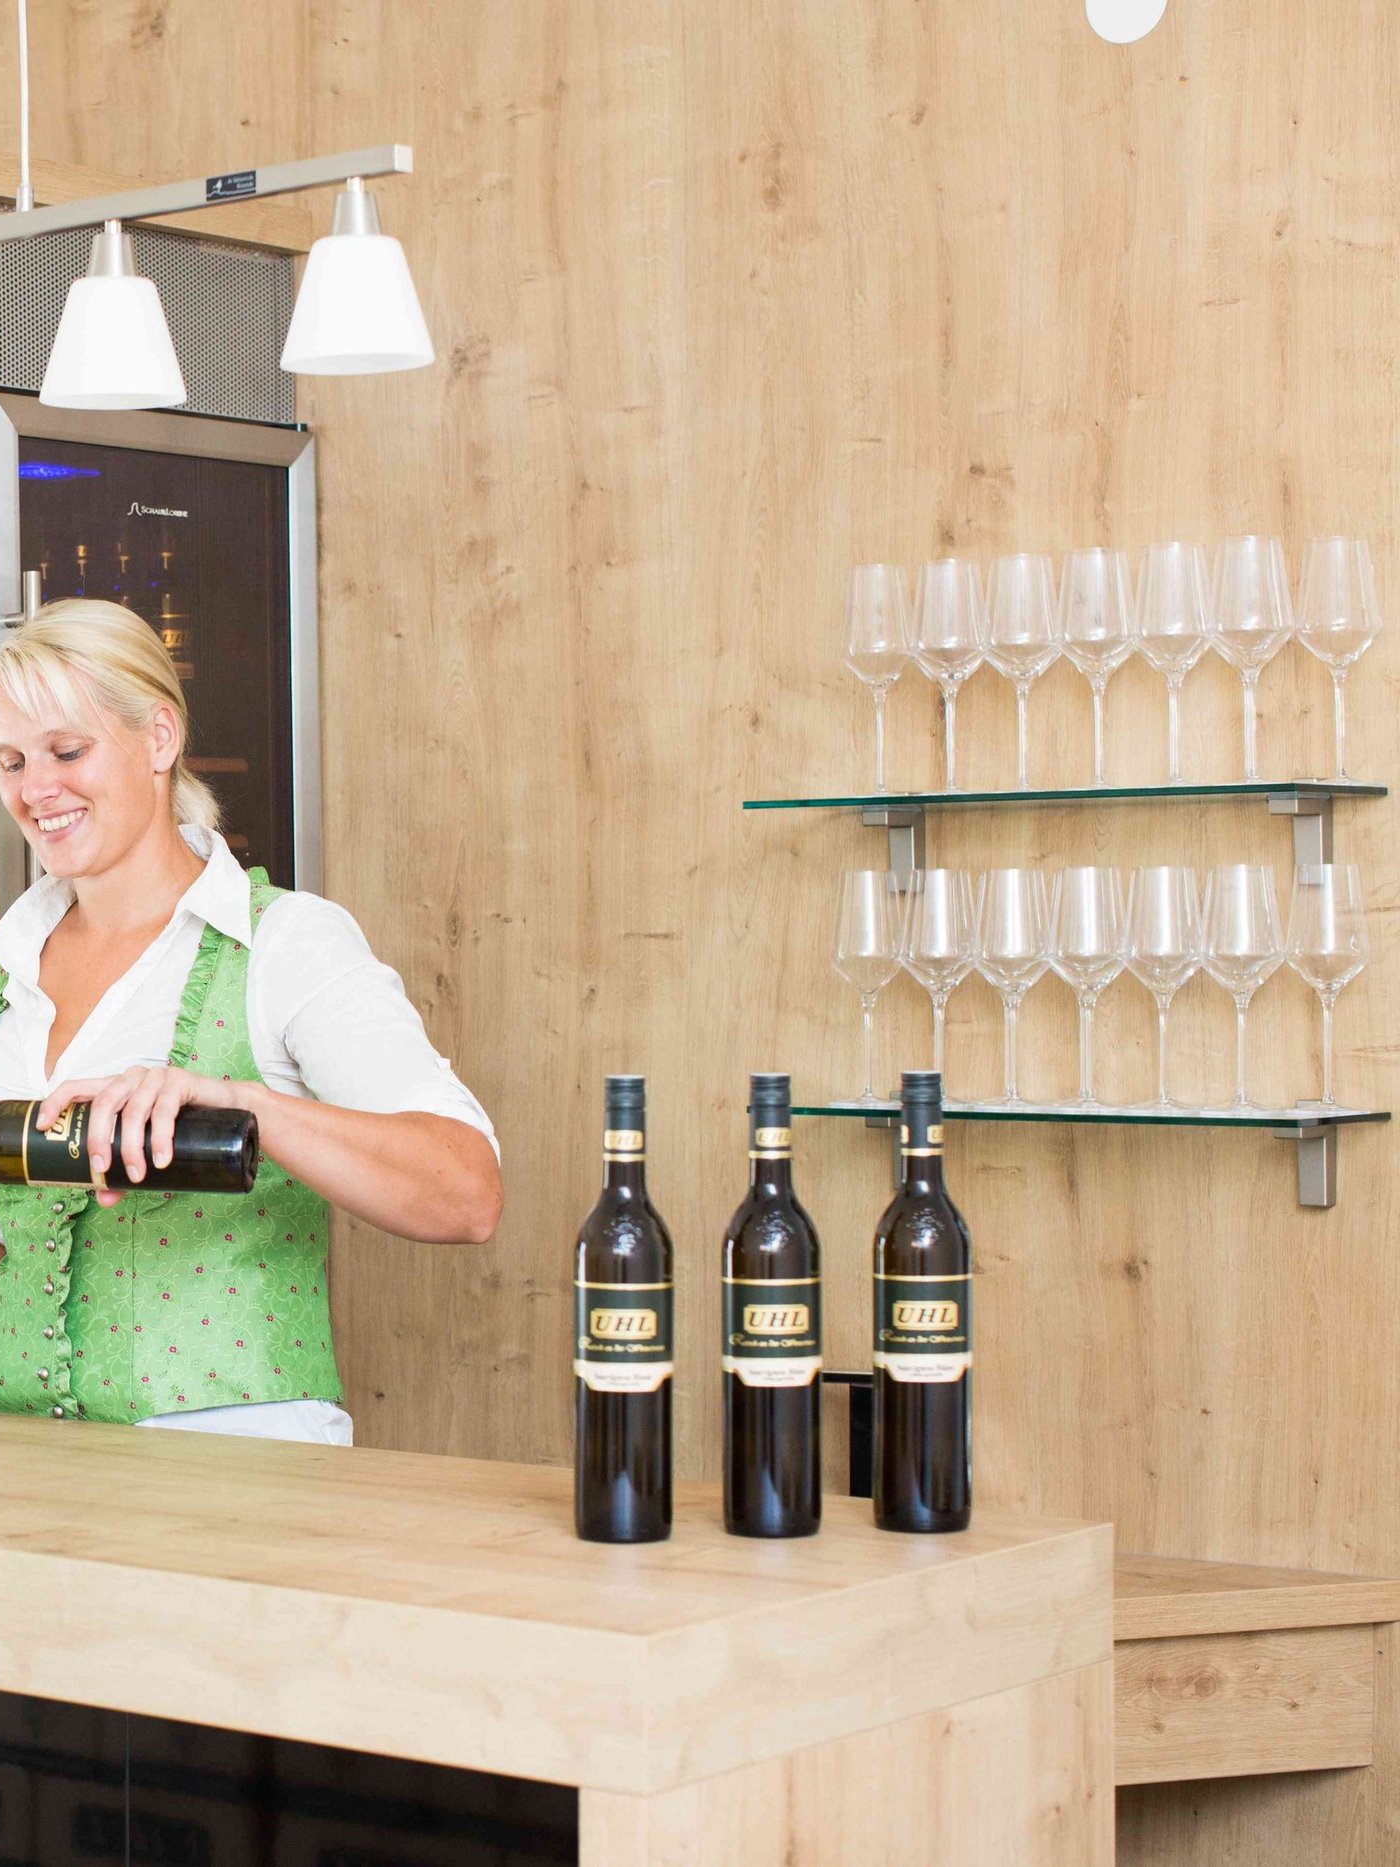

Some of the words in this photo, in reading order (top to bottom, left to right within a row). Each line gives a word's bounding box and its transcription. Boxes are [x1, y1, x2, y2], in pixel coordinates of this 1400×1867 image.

[595, 1315, 652, 1332] UHL
[748, 1311, 805, 1328] UHL
[897, 1307, 955, 1324] UHL
